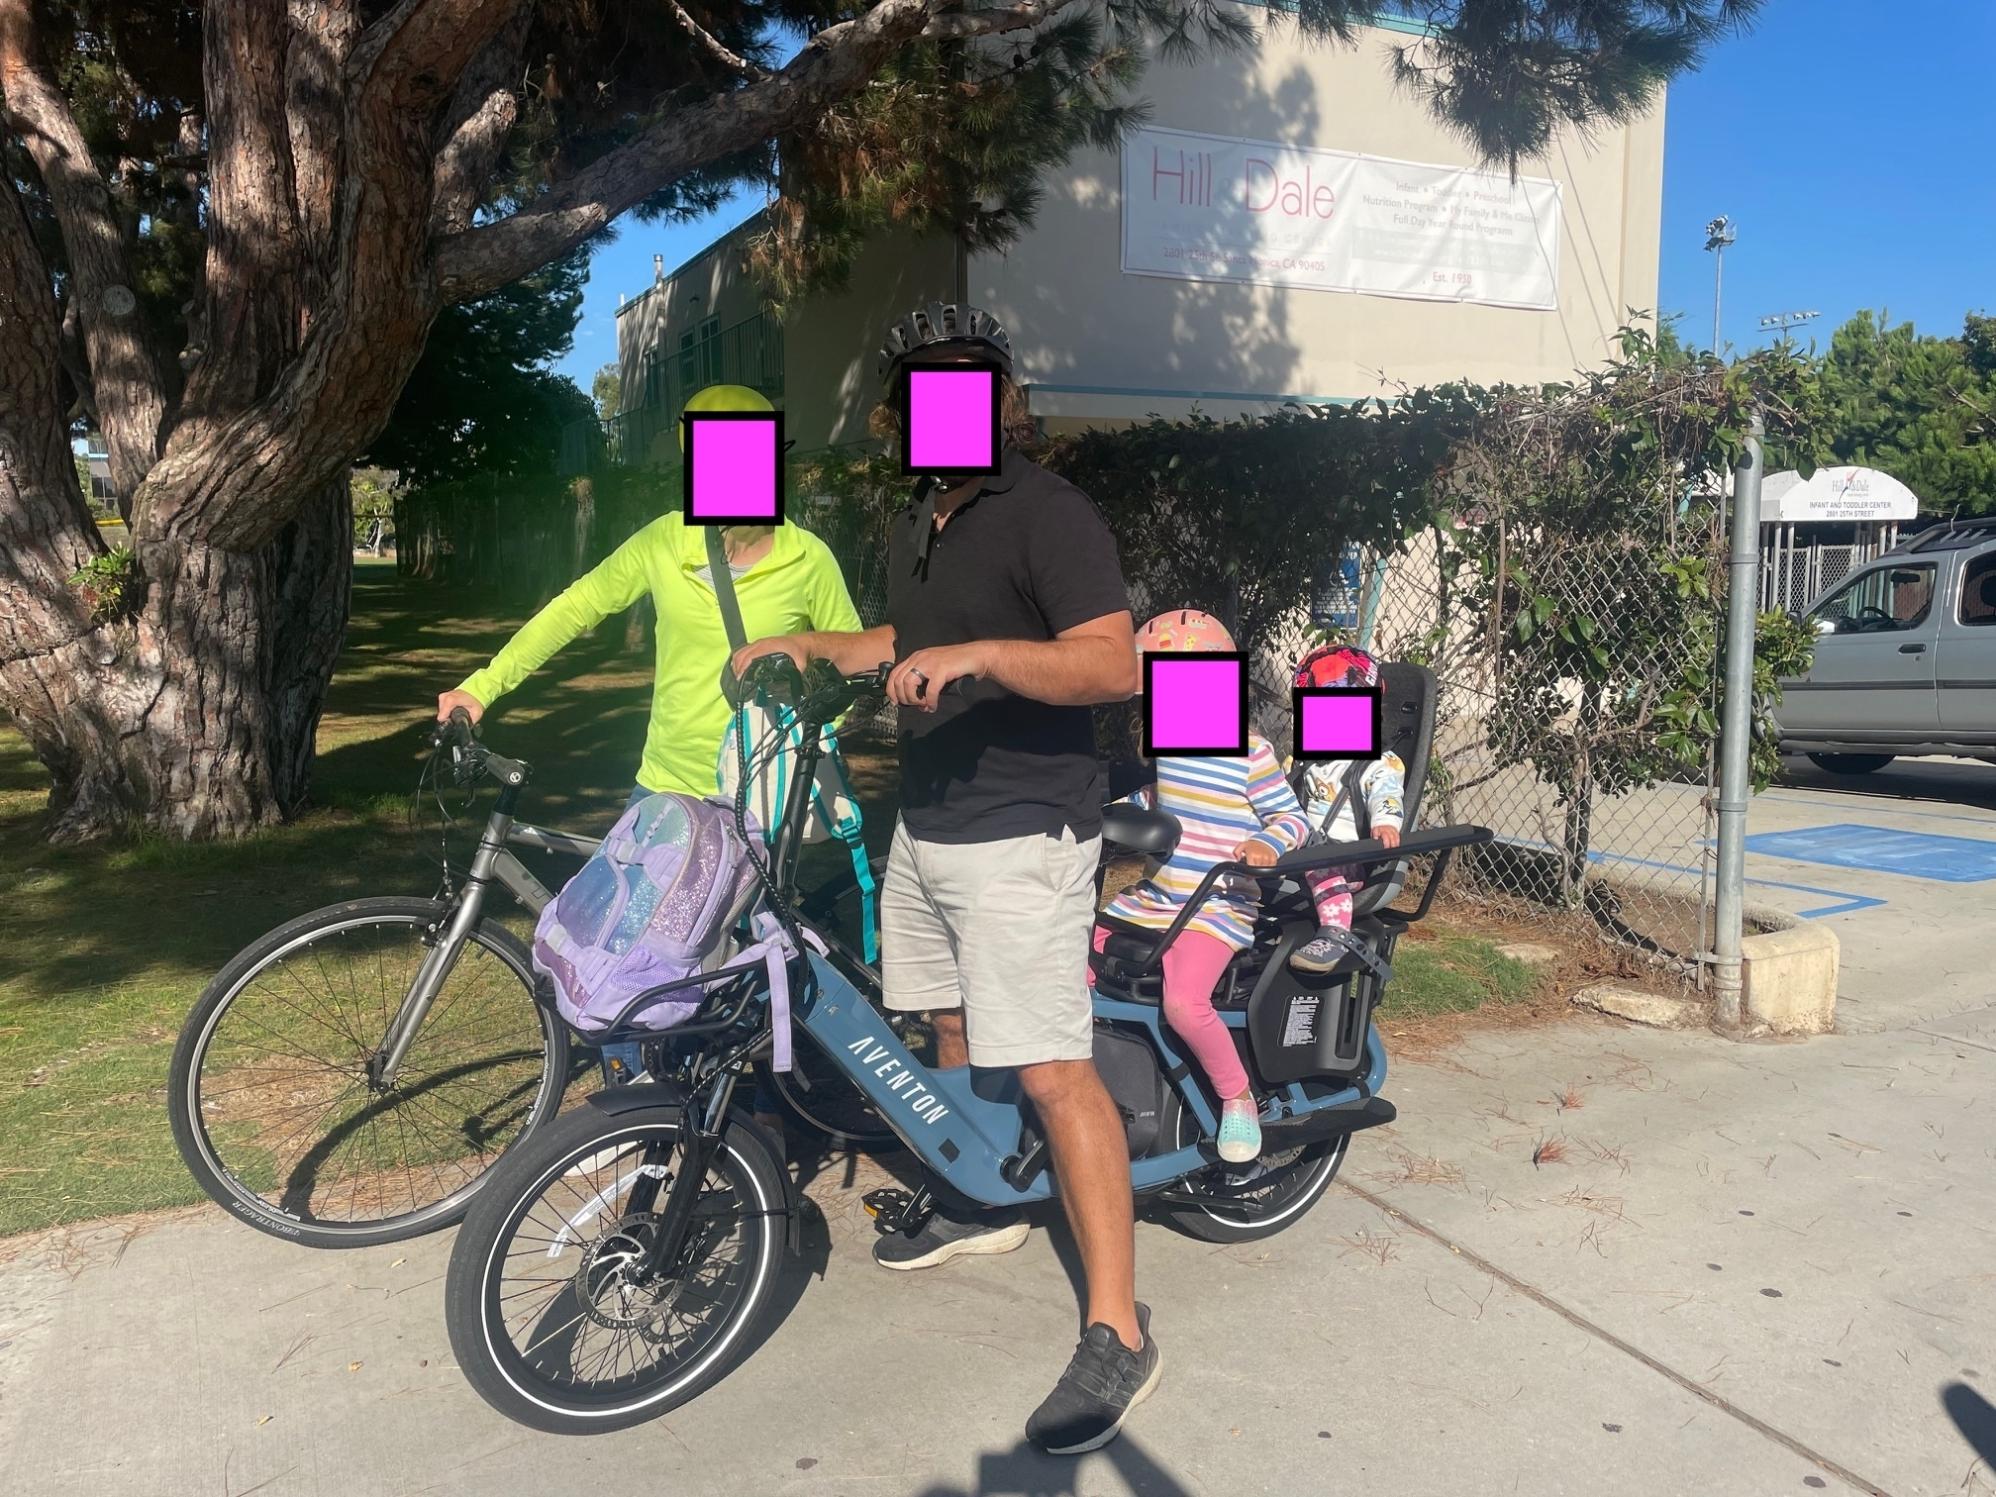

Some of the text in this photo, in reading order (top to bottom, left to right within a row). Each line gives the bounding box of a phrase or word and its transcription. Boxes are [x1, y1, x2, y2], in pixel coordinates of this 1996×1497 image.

[1153, 147, 1336, 219] Hill Dale
[1396, 181, 1419, 194] Infant
[1363, 195, 1402, 209] Nutrition
[1404, 199, 1438, 214] Program
[1464, 206, 1490, 220] Family
[1394, 214, 1409, 225] Full
[1410, 215, 1427, 229] Day
[1282, 257, 1296, 270] CA
[1432, 271, 1449, 283] Est.
[1809, 501, 1892, 509] INFANT AND TODDLER CENTER
[1839, 510, 1853, 518] 25TH
[1854, 510, 1875, 518] STREET
[848, 1036, 949, 1125] AVENTON
[231, 1200, 294, 1236] BONTRAGER
